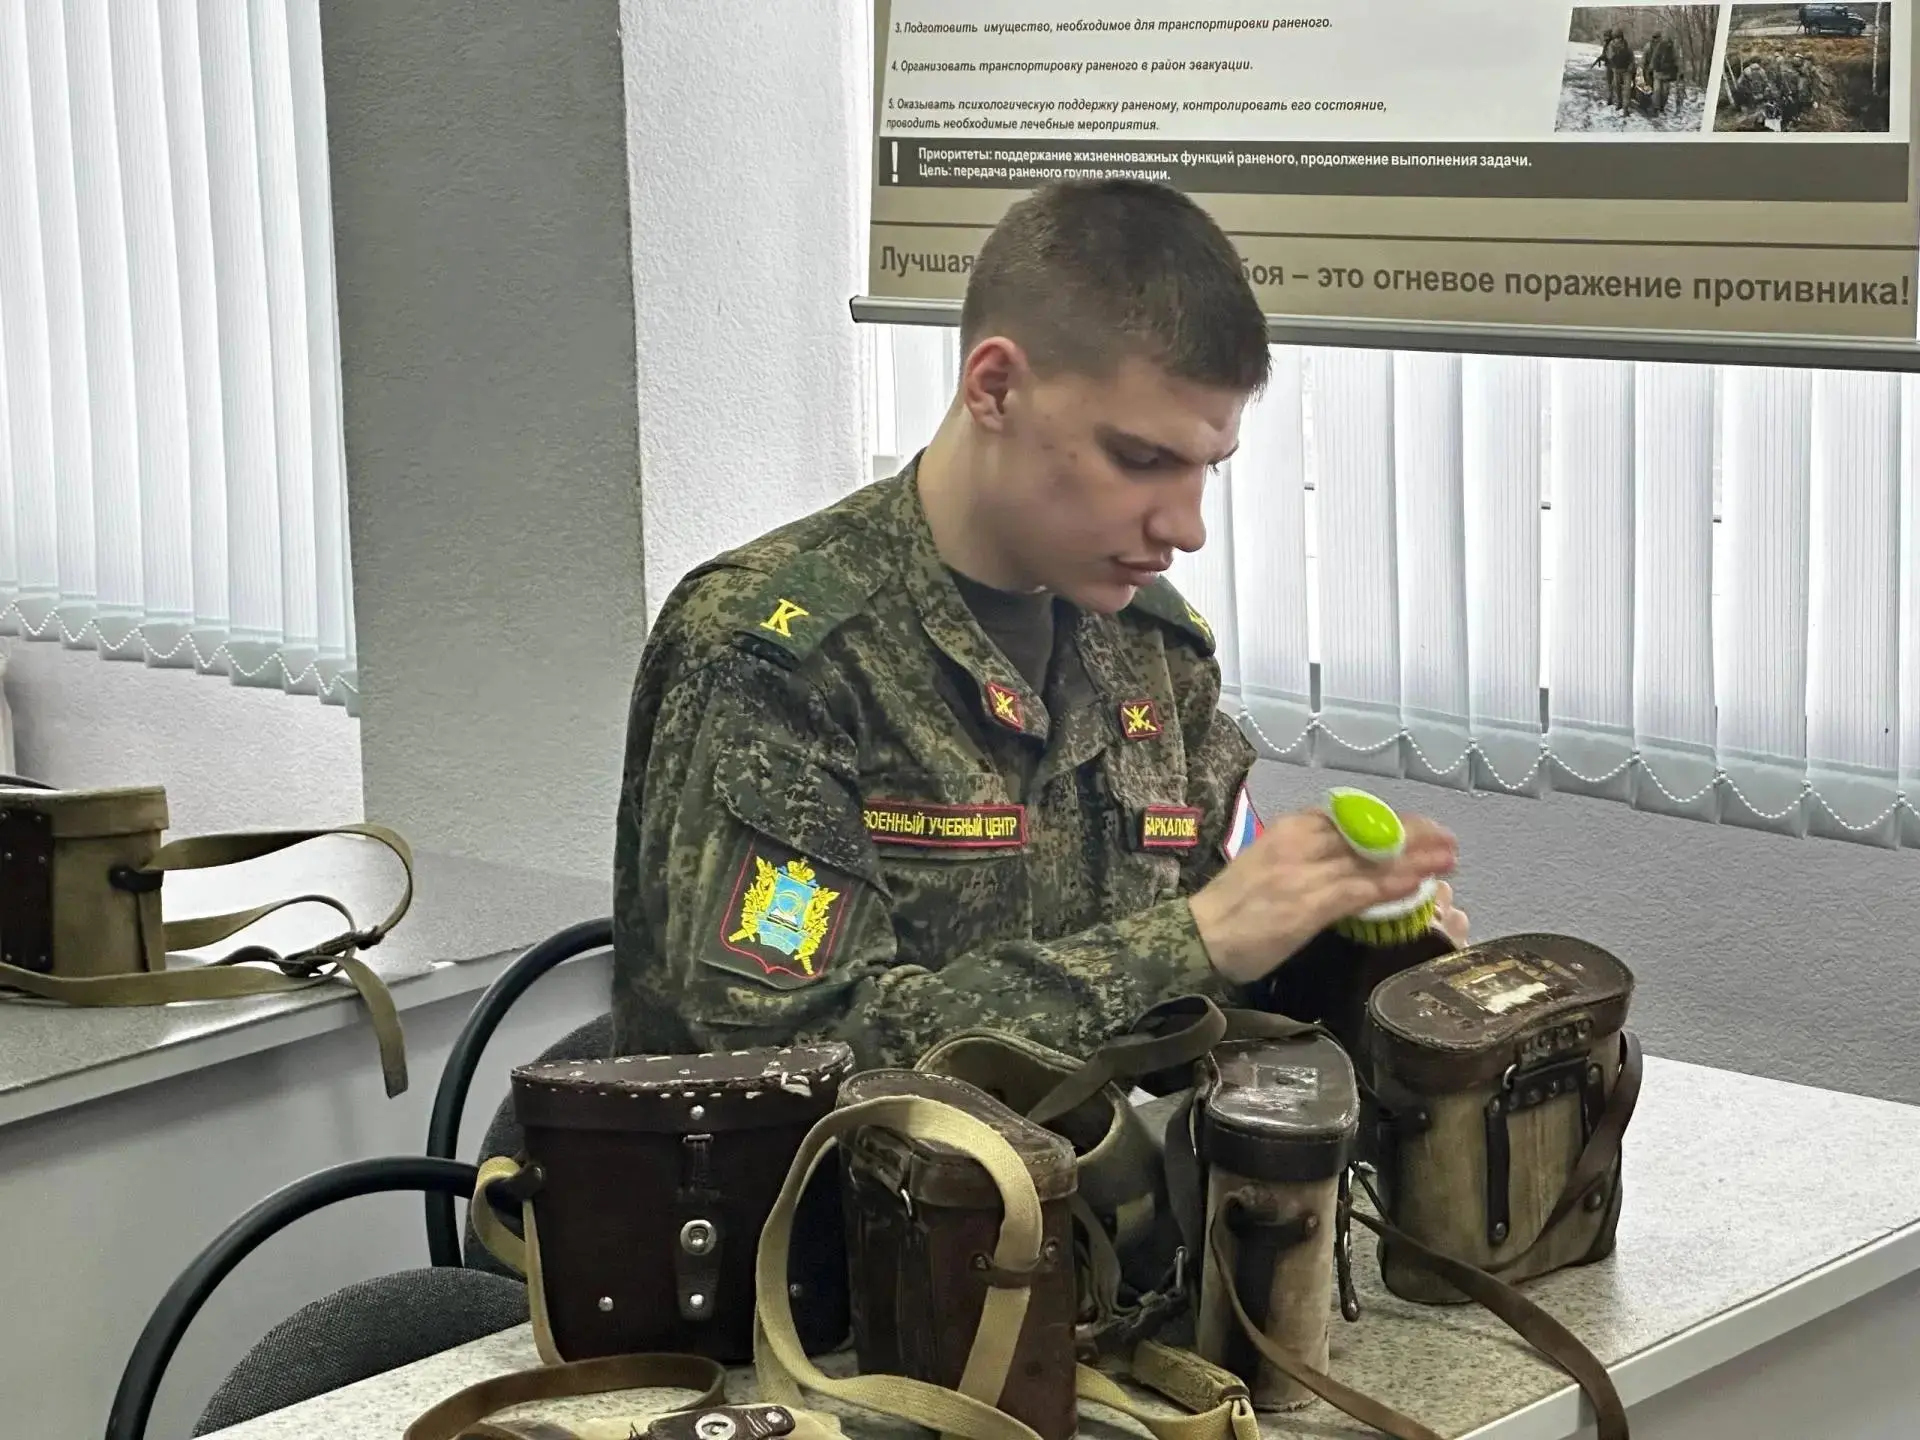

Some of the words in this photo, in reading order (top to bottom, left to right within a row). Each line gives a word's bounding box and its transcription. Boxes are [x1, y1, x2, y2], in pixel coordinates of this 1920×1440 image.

[895, 23, 902, 33] 3.
[904, 22, 978, 34] Подготовить
[983, 23, 1053, 35] имущество,
[1056, 19, 1131, 32] необходимое
[1134, 18, 1155, 31] для
[1158, 19, 1269, 32] транспортировки
[1272, 18, 1333, 31] раненого.
[891, 60, 898, 71] 4.
[900, 60, 976, 72] Организовать
[979, 61, 1083, 73] транспортировку
[1085, 61, 1138, 73] раненого
[1141, 62, 1148, 70] в
[1150, 58, 1186, 72] район
[1188, 61, 1253, 72] эвакуации.
[897, 98, 955, 110] Оказывать
[958, 99, 1055, 112] психологическую
[1057, 98, 1118, 112] поддержку
[1120, 101, 1179, 112] раненому,
[1183, 101, 1287, 112] контролировать
[1291, 101, 1311, 111] его
[1314, 101, 1387, 112] состояние,
[886, 119, 940, 129] проводить
[943, 117, 1017, 129] необходимые
[1020, 117, 1074, 130] лечебные
[1077, 121, 1160, 131] мероприятия.
[918, 147, 992, 161] Приоритеты:
[994, 151, 1072, 163] поддержание
[1073, 151, 1179, 164] жизненноважных
[1180, 150, 1235, 166] функций
[1237, 153, 1299, 167] раненого,
[1300, 154, 1389, 167] продолжение
[1391, 155, 1478, 167] выполнения
[1479, 156, 1532, 168] задачи.
[919, 164, 952, 177] Цель:
[953, 167, 1007, 178] передача
[1008, 167, 1063, 180] раненого
[881, 246, 975, 278] Лучшая
[1317, 267, 1364, 288] это
[1373, 268, 1495, 293] огневое
[1504, 271, 1682, 302] поражение
[1693, 275, 1909, 307] противника!
[928, 812, 983, 837] УЧЕБНЫЙ
[985, 816, 1017, 840] ЦЕНТР
